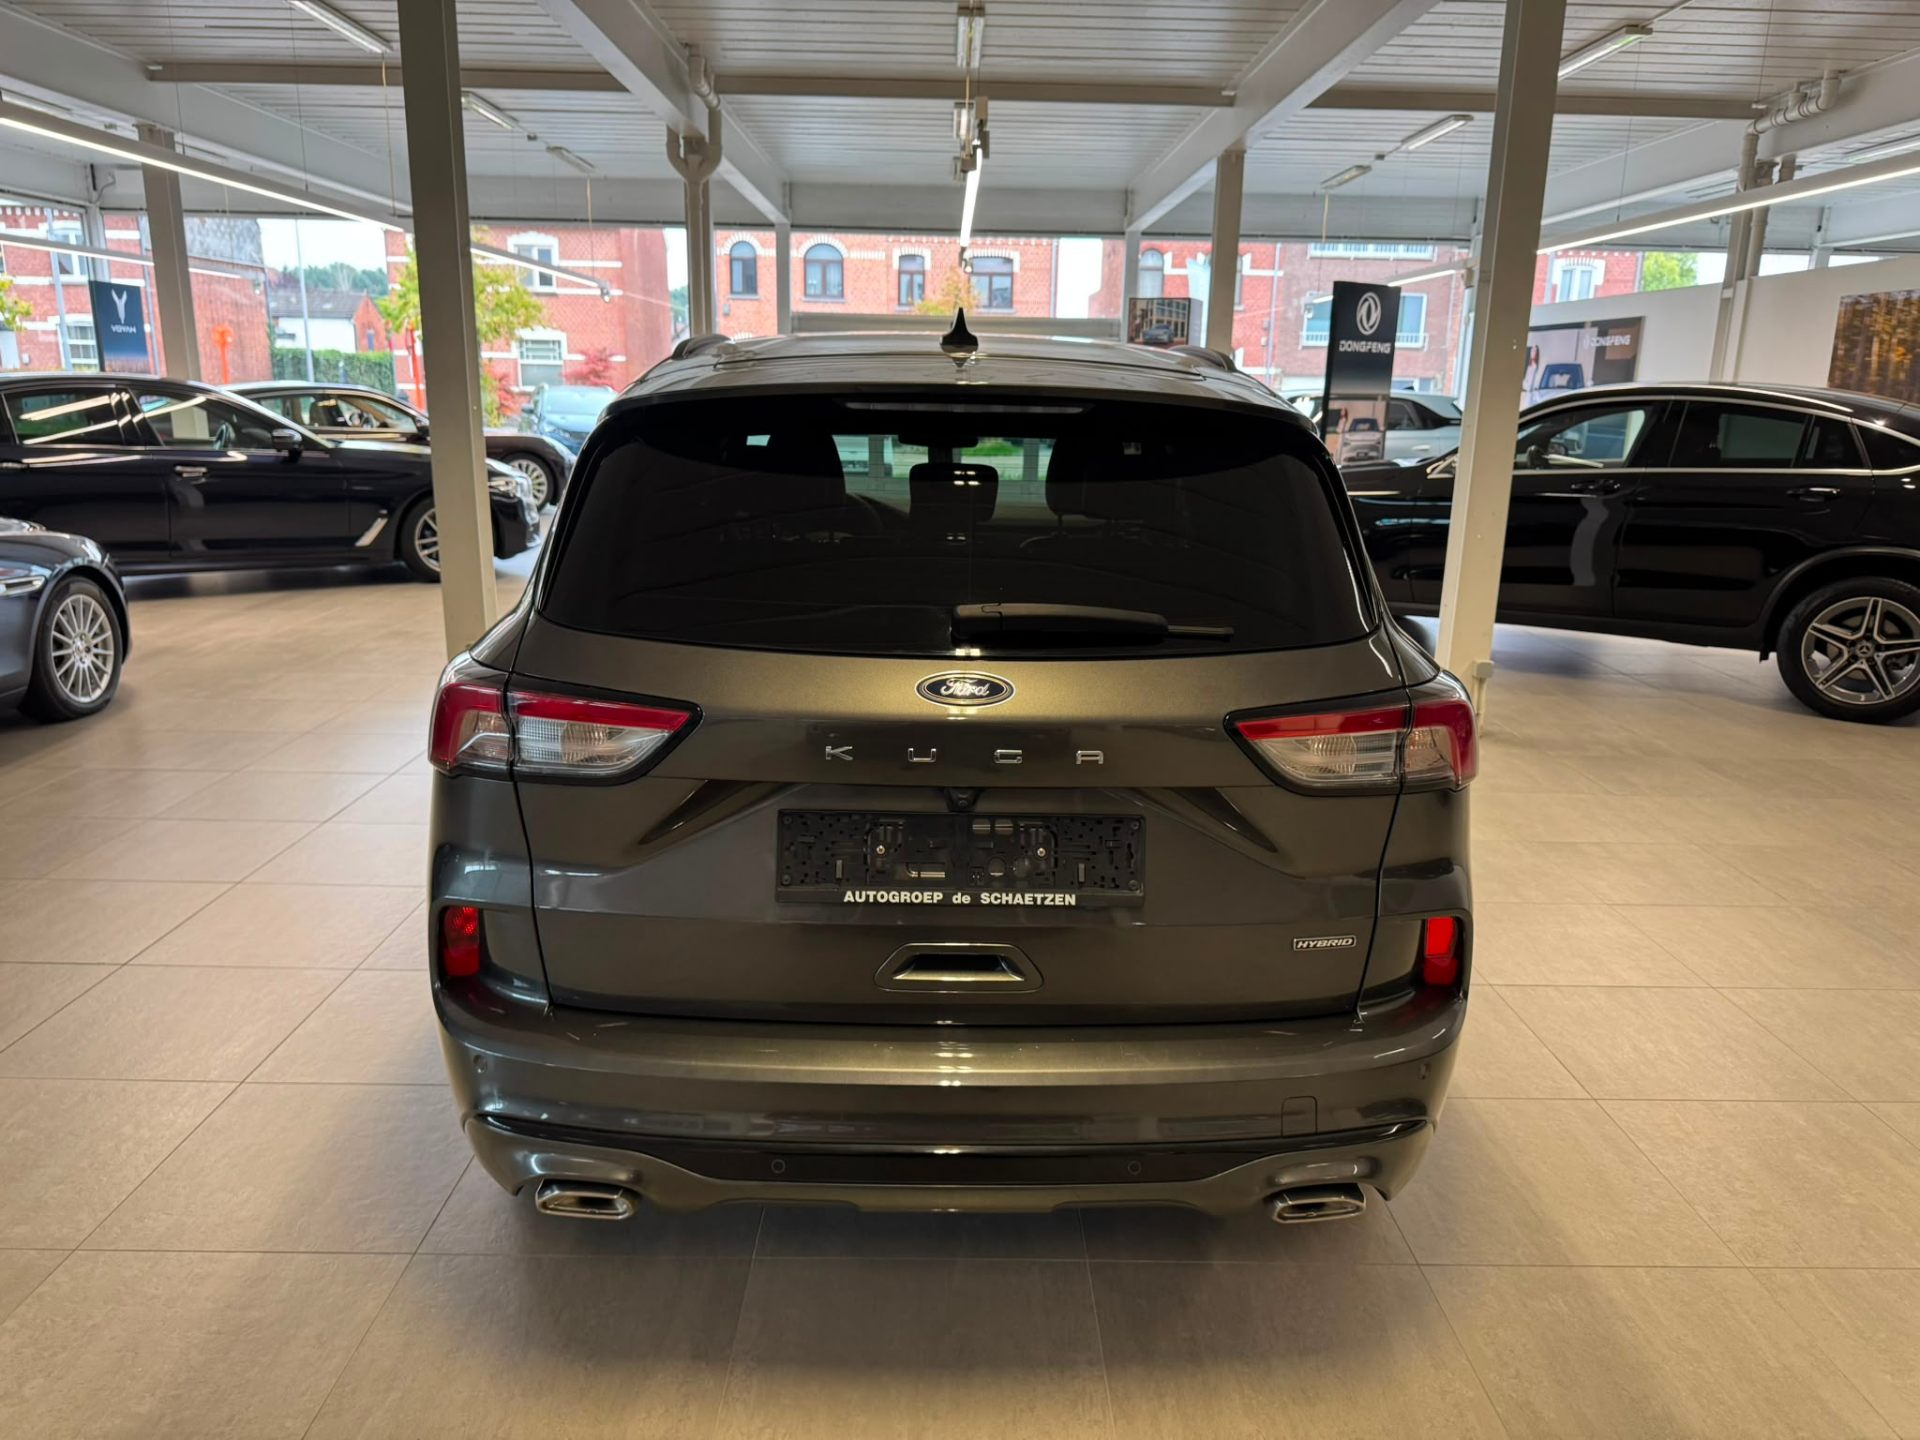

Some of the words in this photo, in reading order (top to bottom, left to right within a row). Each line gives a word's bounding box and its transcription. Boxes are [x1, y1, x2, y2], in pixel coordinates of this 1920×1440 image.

[1339, 340, 1391, 354] DONGFENG
[940, 678, 990, 697] Ford
[825, 745, 1105, 765] KUGA
[843, 890, 944, 905] AUTOGROEP
[952, 892, 971, 905] de
[980, 892, 1077, 907] SCHAETZEN
[1297, 938, 1353, 949] HYBRID
